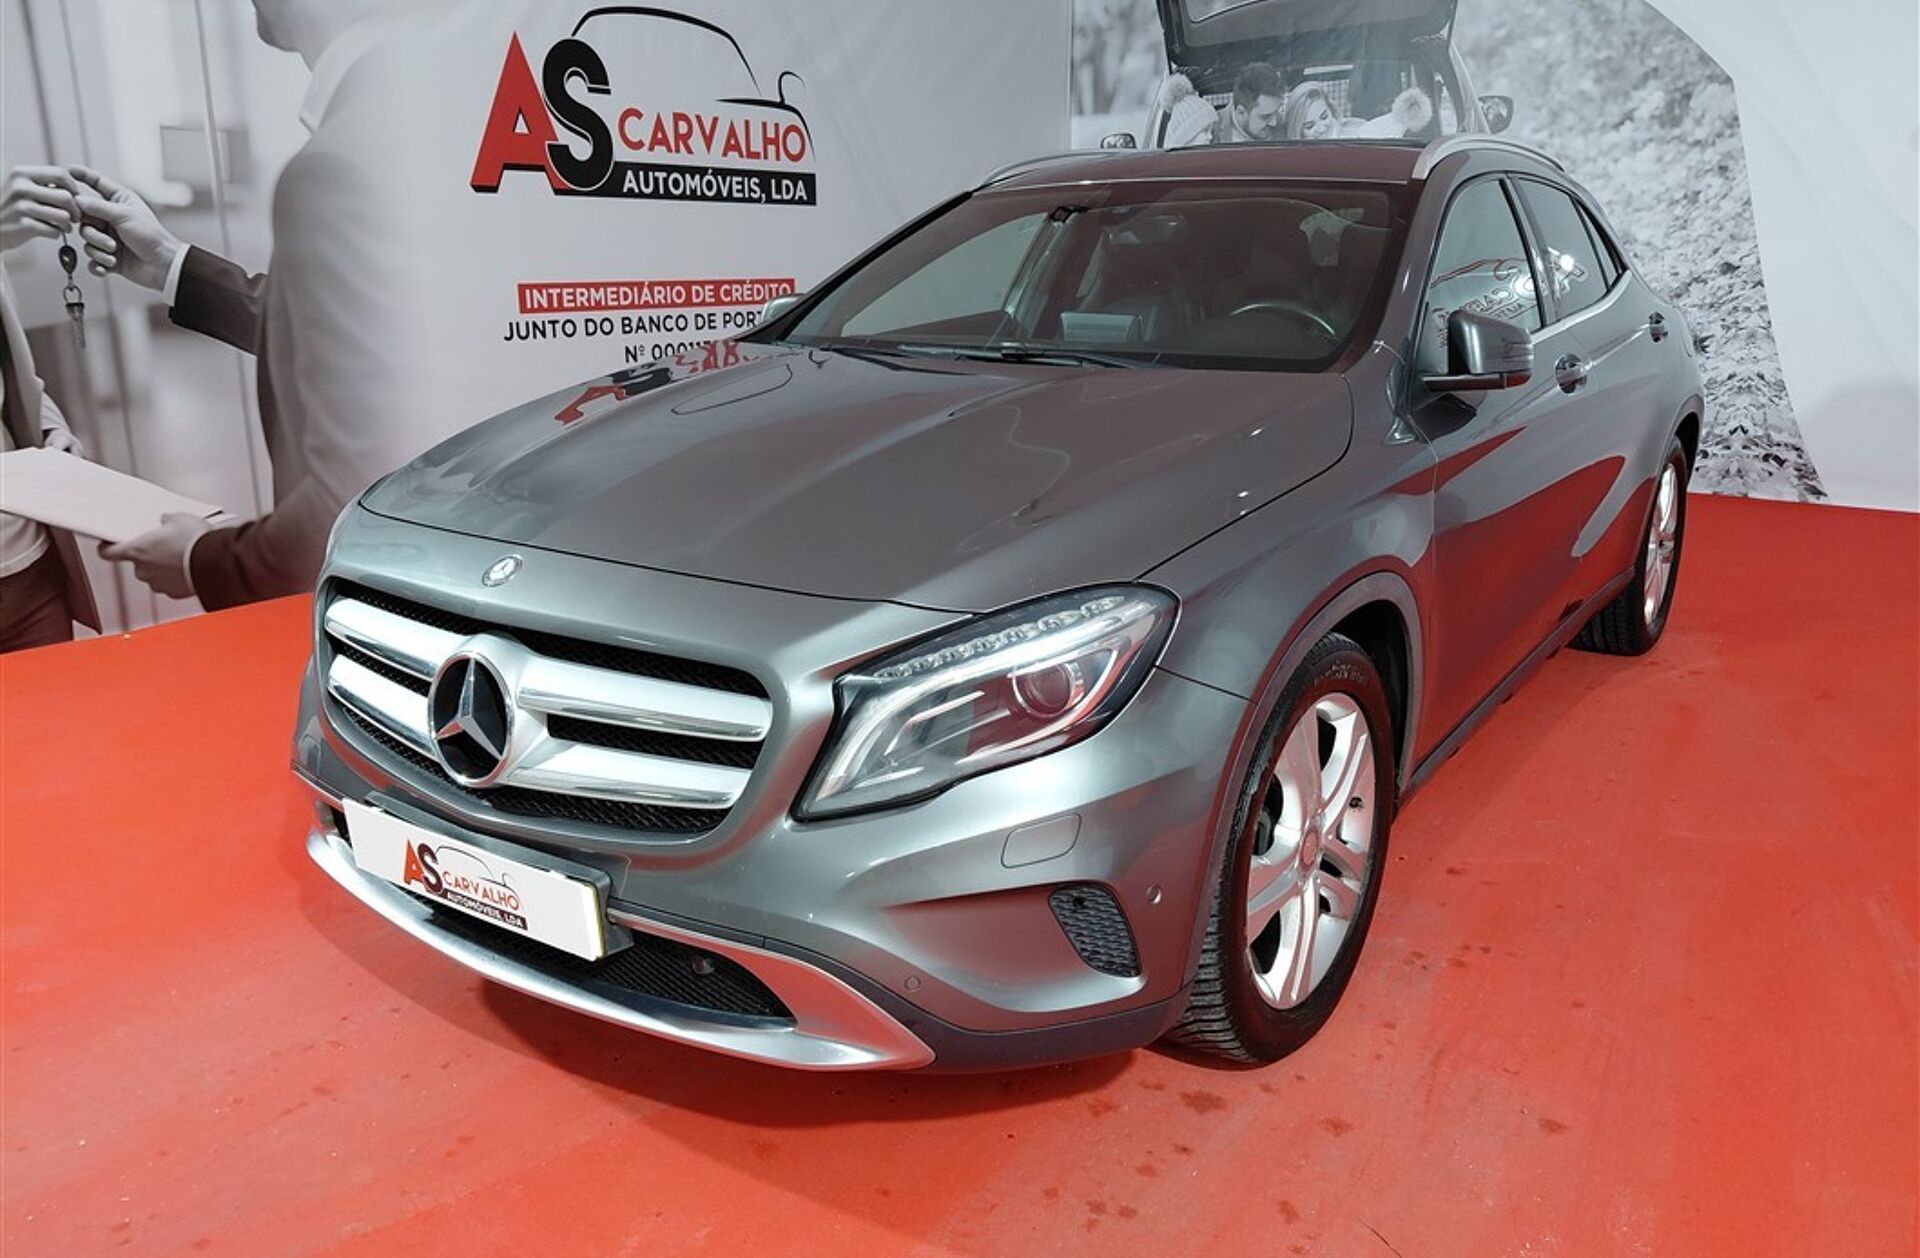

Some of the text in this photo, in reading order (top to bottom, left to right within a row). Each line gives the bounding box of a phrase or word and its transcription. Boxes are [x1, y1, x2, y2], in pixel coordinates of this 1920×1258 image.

[470, 30, 807, 196] AS CARVALHO
[622, 169, 808, 203] AUTOMÓVEIS, LDA
[524, 279, 792, 309] INTERMEDIÁRIO DE CRÉDITO
[503, 315, 578, 342] JUNTO
[584, 316, 615, 337] DO
[620, 312, 689, 335] BANCO
[694, 310, 718, 331] DE
[403, 839, 520, 911] AS CARVALHO
